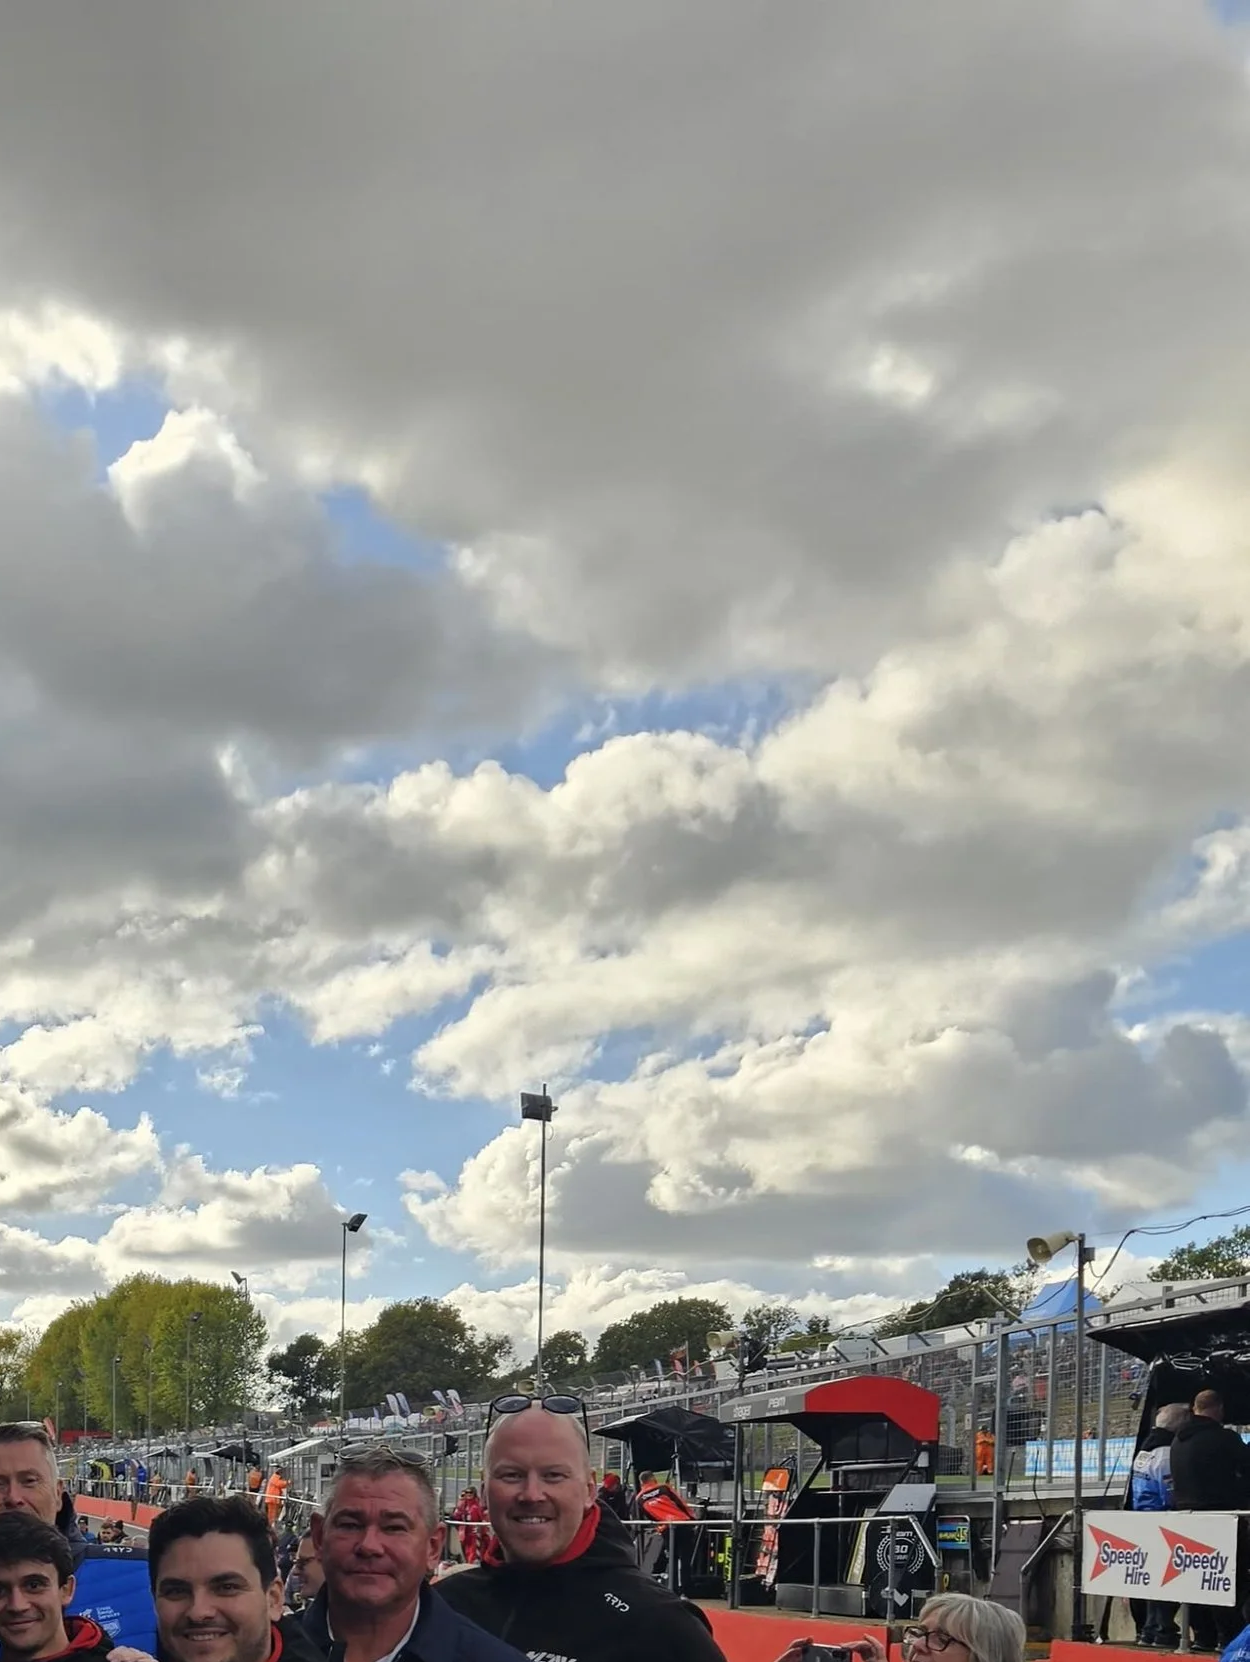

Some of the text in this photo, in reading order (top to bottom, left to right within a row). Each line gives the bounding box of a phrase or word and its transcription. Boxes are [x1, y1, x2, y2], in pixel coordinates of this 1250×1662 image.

[1101, 1542, 1148, 1569] Speedy
[1173, 1545, 1229, 1574] Speedy
[1124, 1566, 1150, 1586] Hire
[1201, 1571, 1231, 1592] Hire
